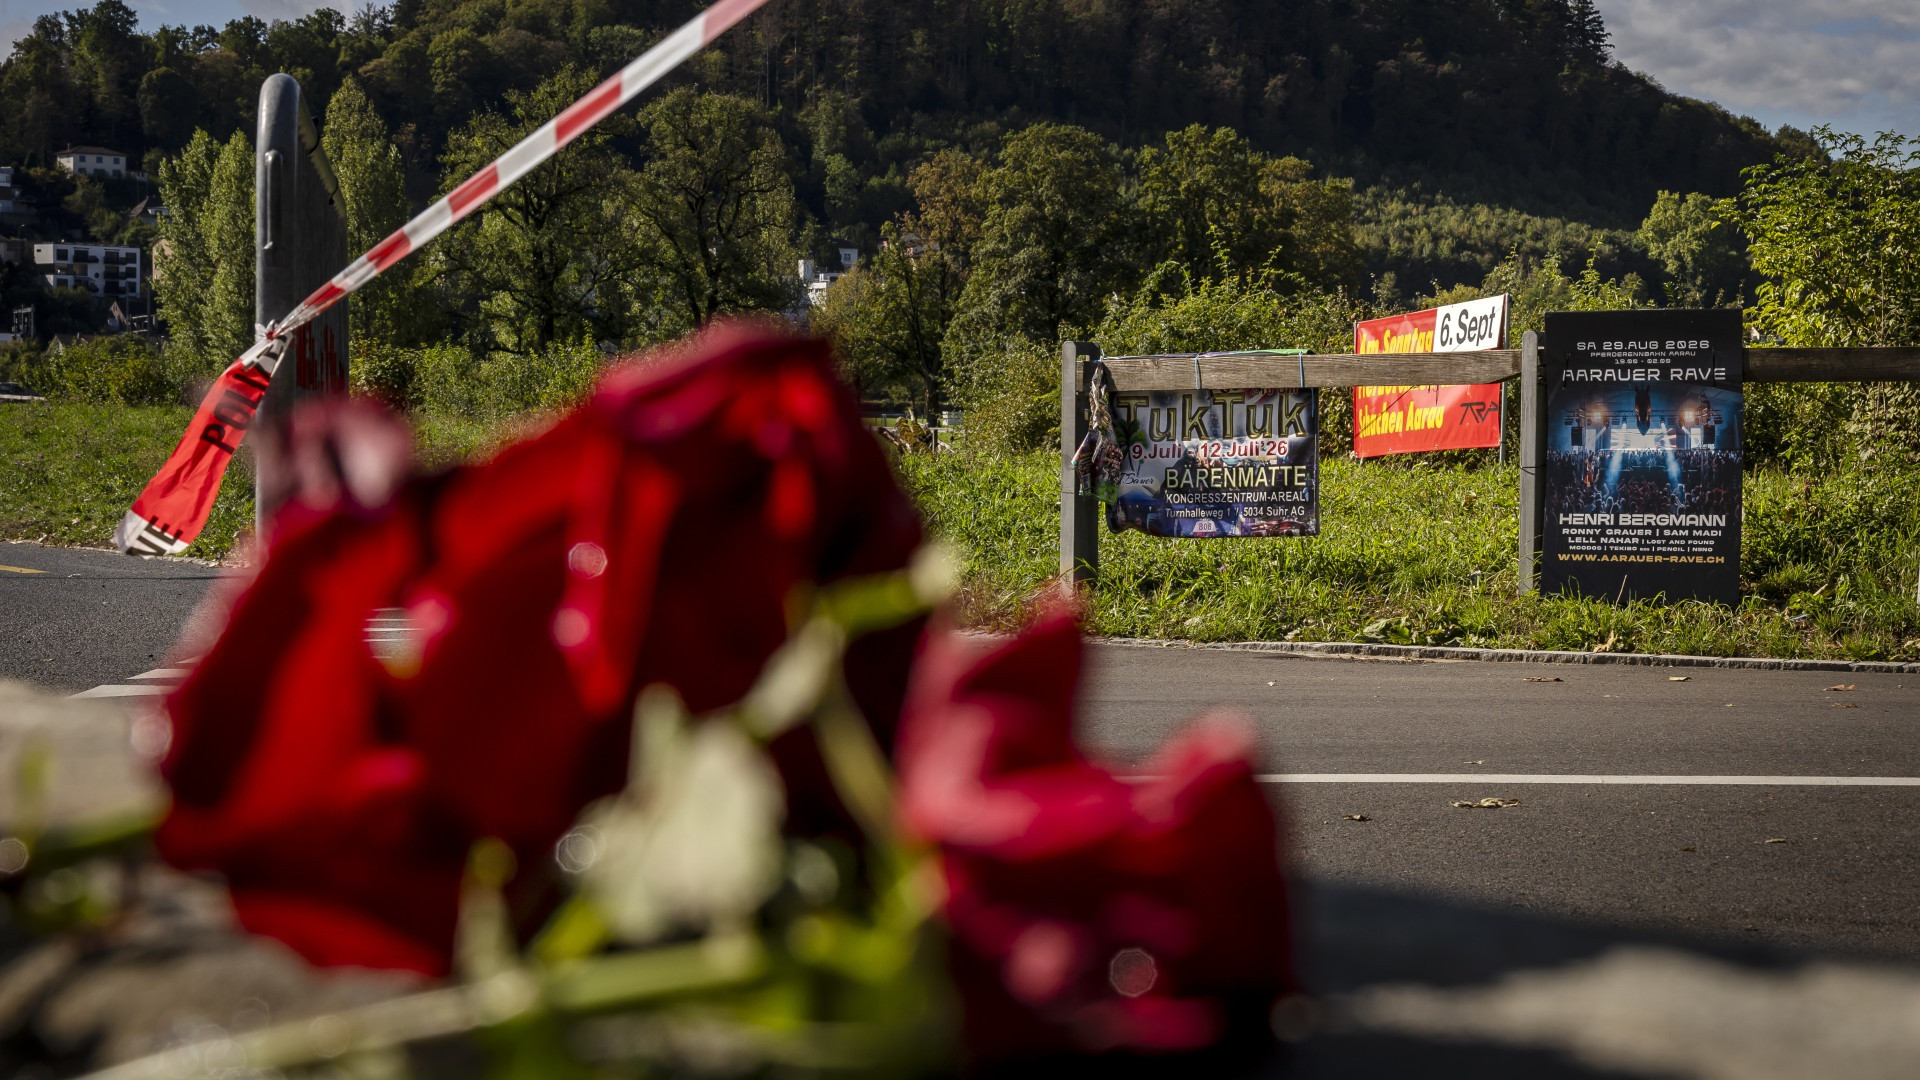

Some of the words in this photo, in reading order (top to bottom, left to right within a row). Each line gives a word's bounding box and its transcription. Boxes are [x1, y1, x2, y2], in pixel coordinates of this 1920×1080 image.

[1383, 328, 1433, 354] Sonntag
[1440, 313, 1452, 347] 6.
[1457, 306, 1496, 347] Sept
[1577, 341, 1596, 350] SA
[1603, 340, 1658, 350] 29.AUG
[1665, 340, 1710, 349] 2026
[1562, 367, 1660, 382] AARAUER
[1670, 367, 1726, 381] RAVE
[1359, 401, 1404, 438] Schachen
[1405, 400, 1445, 432] Aarau
[1132, 443, 1182, 460] 9.Juli
[1165, 464, 1307, 488] BÄRENMATTE
[1166, 491, 1305, 504] KONGRESSZENTRUM-AREAL
[1166, 508, 1224, 519] Turnhalleweg
[1243, 506, 1264, 517] 5034
[1266, 506, 1289, 516] Suhr
[1290, 506, 1305, 516] AG
[1559, 513, 1614, 525] HENRI
[1618, 513, 1726, 527] BERGMANN
[1663, 529, 1689, 537] SAM
[1557, 553, 1725, 564] WWW.AARAUER-RAVE.CH
